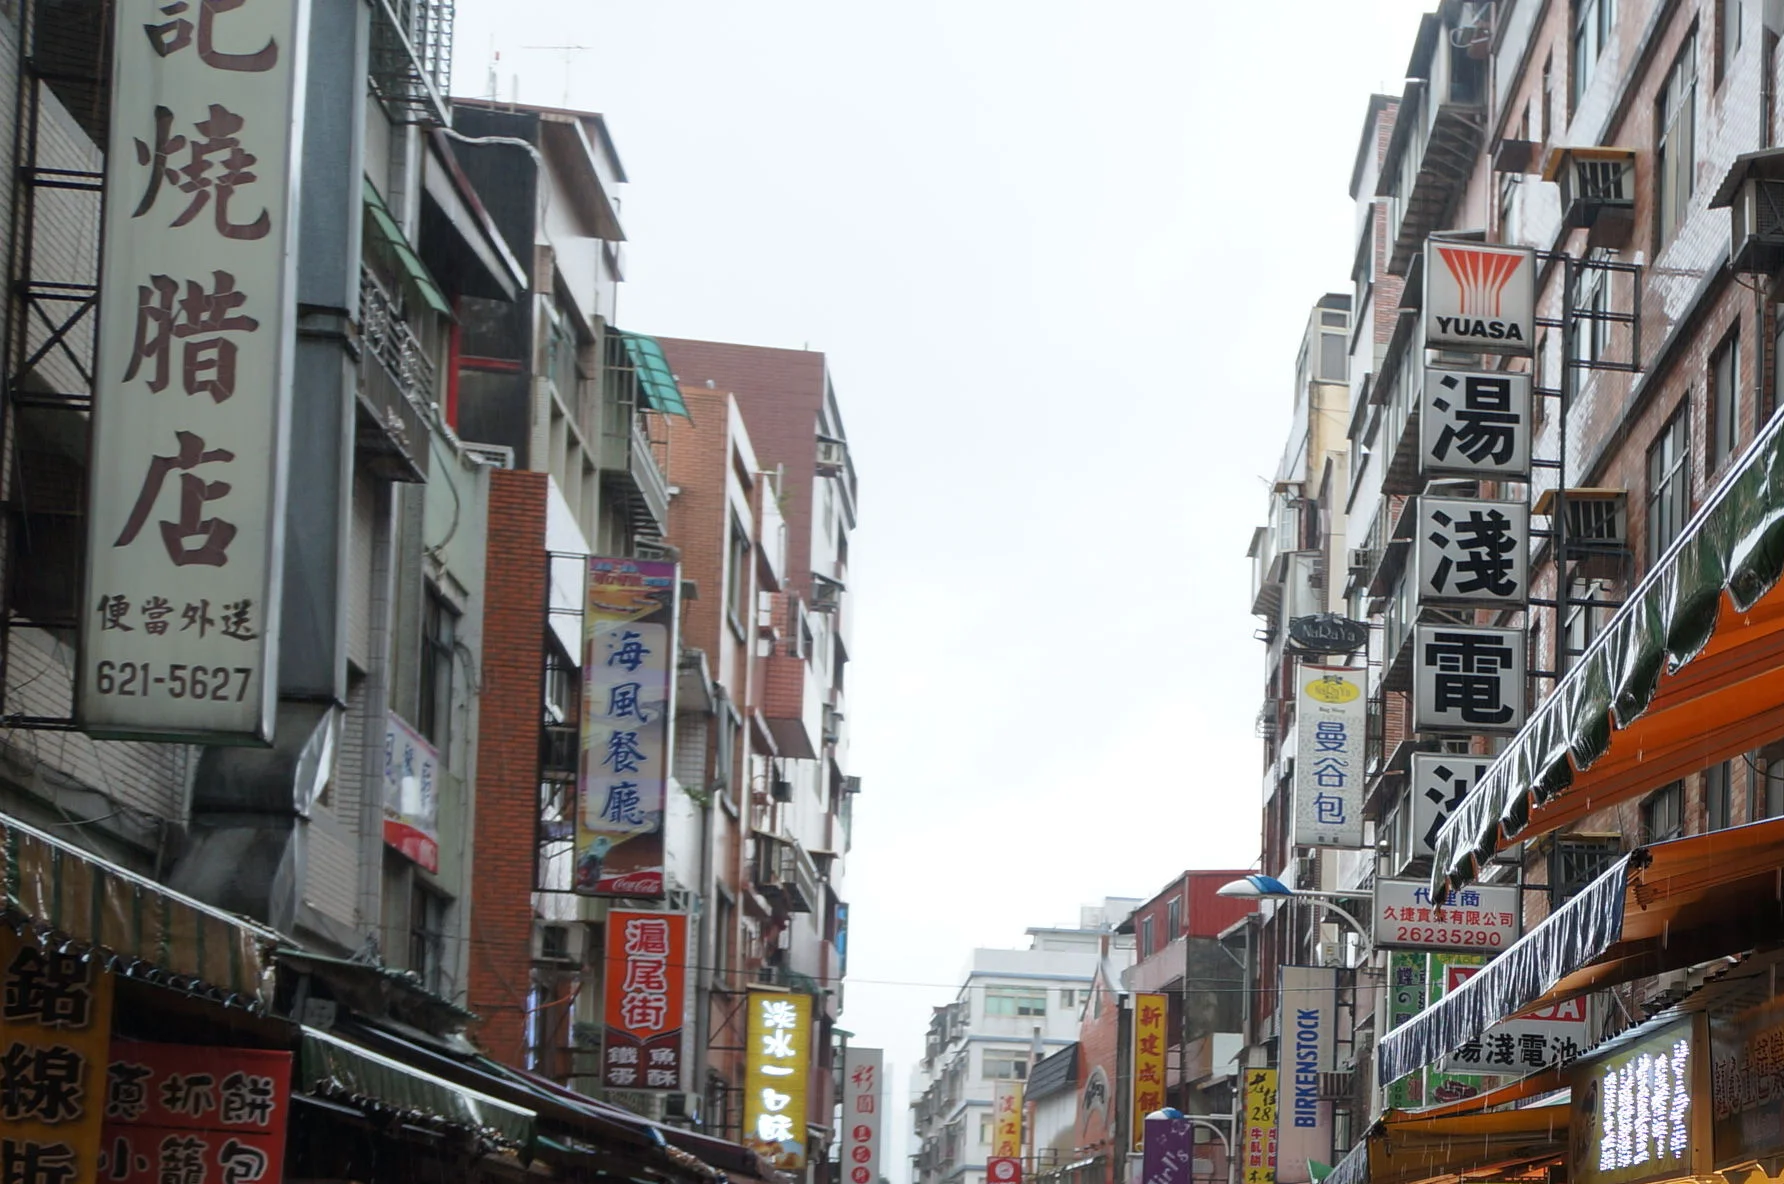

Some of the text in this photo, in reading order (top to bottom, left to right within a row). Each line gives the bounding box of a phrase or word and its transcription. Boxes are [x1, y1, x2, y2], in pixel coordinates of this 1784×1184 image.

[1436, 315, 1524, 341] YUASA
[97, 593, 260, 643] 便當外送
[1301, 624, 1357, 642] NaRaYa
[96, 660, 253, 704] 621-5627
[600, 631, 651, 826] 海風餐廳
[1313, 720, 1349, 826] 曼谷包
[1384, 905, 1514, 928] 久捷實業有限公司
[1397, 926, 1502, 947] 26235290
[623, 917, 670, 1031] 滬尾街
[757, 1000, 797, 1142] 淡水一口酥
[1135, 1004, 1164, 1114] 新建成餅
[1294, 1008, 1320, 1128] BIRKENSTOCK
[1452, 1033, 1580, 1070] 湯淺電池
